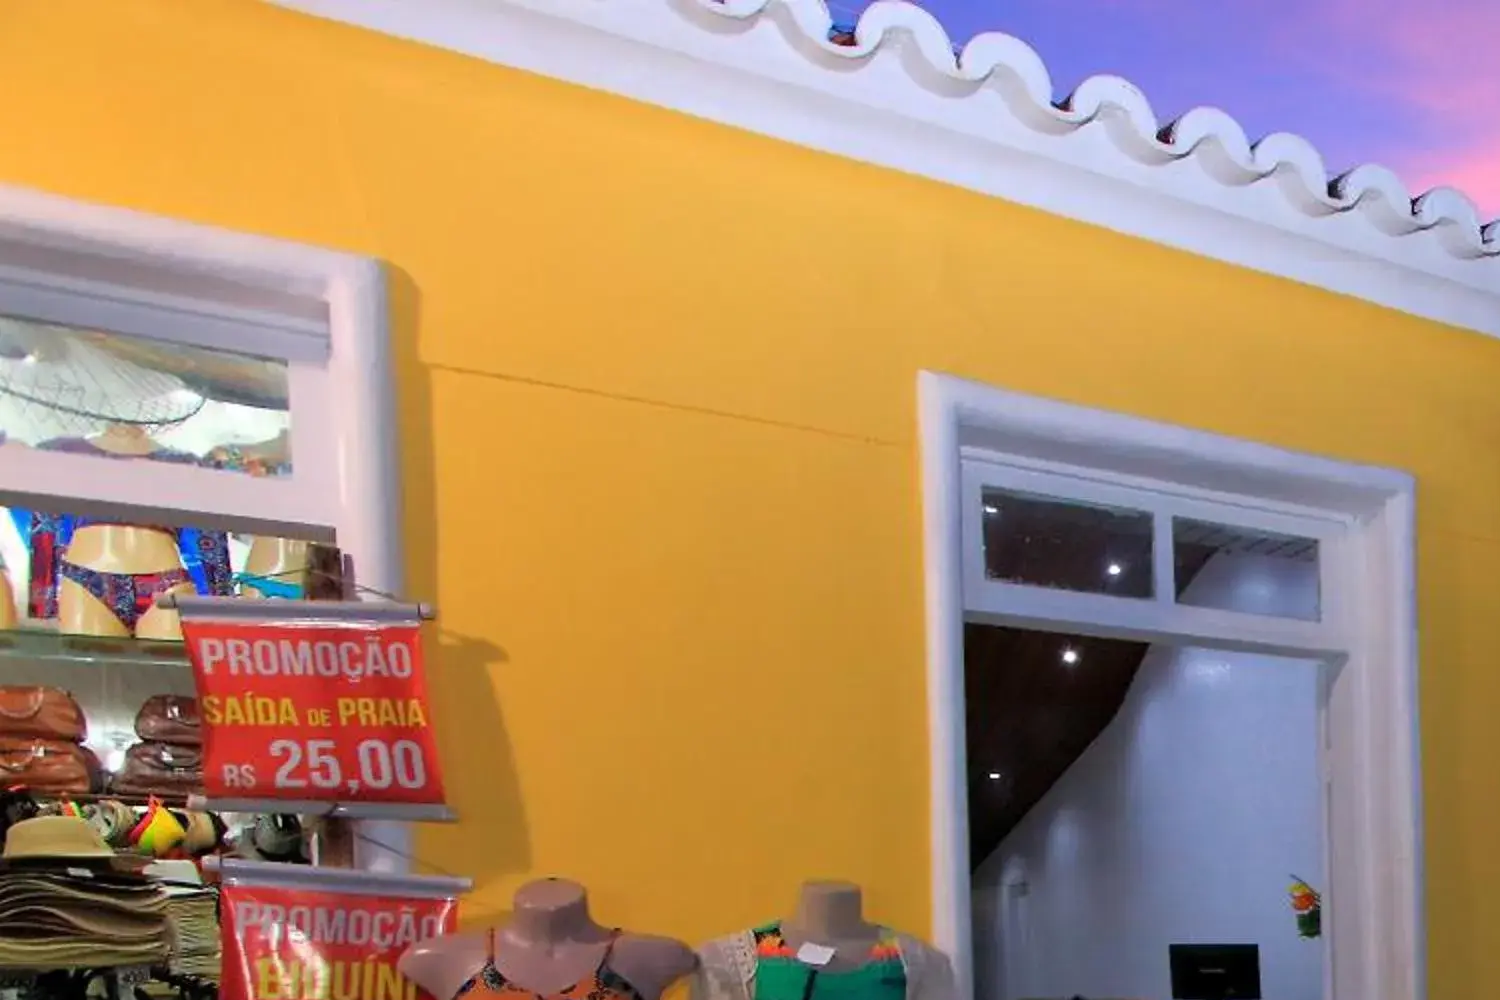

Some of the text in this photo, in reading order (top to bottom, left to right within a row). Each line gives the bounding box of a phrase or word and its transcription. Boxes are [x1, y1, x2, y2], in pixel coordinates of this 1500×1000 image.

[199, 635, 412, 683] PROMOÇÃO
[202, 691, 427, 728] SAÍDA DE PRAIA
[269, 739, 427, 794] 25,00
